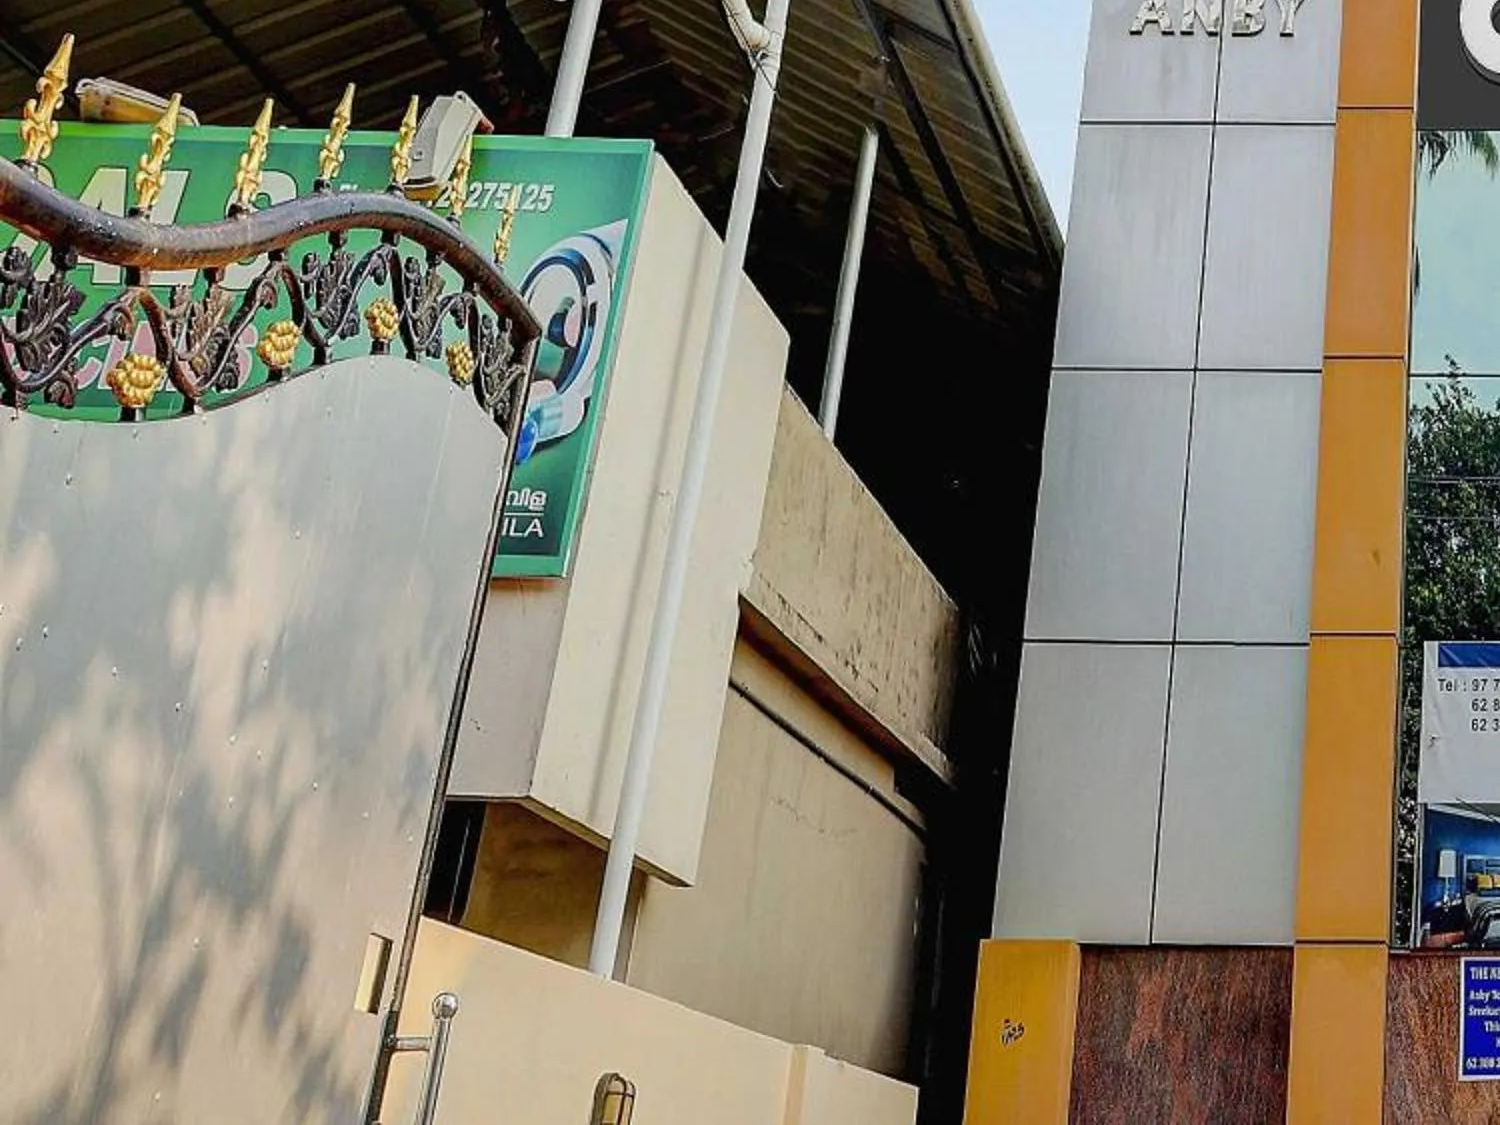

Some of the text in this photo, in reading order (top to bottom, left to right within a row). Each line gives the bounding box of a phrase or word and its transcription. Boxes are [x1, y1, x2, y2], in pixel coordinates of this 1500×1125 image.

[502, 517, 544, 538] ILA
[1438, 678, 1457, 692] Tel
[1471, 678, 1488, 692] 97
[1471, 698, 1488, 712] 62
[1471, 718, 1488, 732] 62
[1470, 967, 1489, 980] THE
